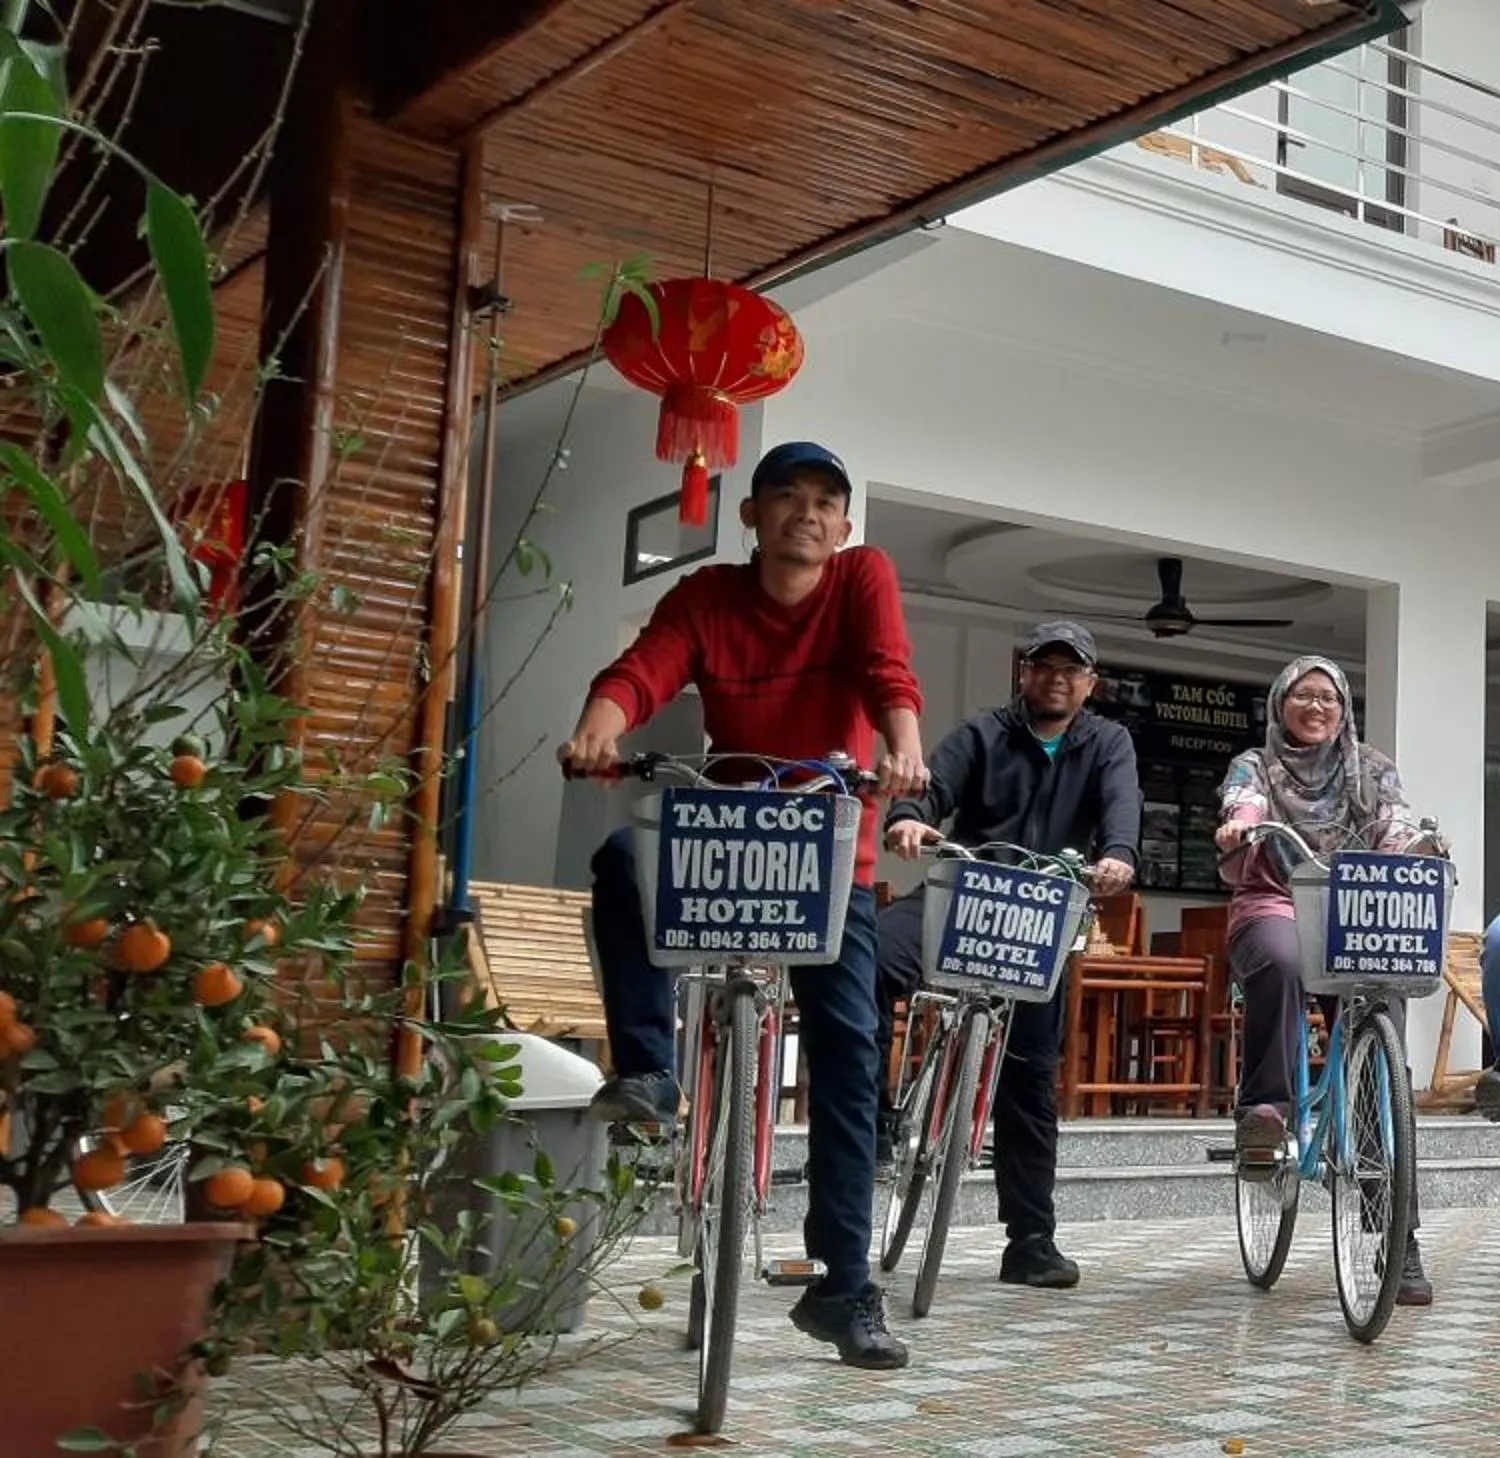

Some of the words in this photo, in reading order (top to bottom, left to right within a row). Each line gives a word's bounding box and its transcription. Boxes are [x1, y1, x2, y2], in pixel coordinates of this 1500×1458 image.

[1171, 684, 1203, 703] TAM
[1155, 702, 1211, 725] VICTORIA
[1213, 709, 1249, 729] HOTEL
[1171, 735, 1232, 753] RECEPTION
[673, 803, 746, 829] TAM
[755, 797, 825, 831] CỐC
[671, 838, 820, 892] VICTORIA
[1337, 863, 1389, 883] TAM
[1394, 860, 1439, 886] CỐC
[963, 871, 1013, 895] TAM
[1017, 879, 1064, 905] CỐC
[680, 897, 806, 925] HOTEL
[955, 894, 1056, 947] VICTORIA
[1337, 889, 1437, 930] VICTORIA
[700, 930, 744, 949] 0942
[748, 931, 781, 950] 364
[785, 931, 817, 950] 706
[956, 935, 1040, 968] HOTEL
[1344, 932, 1429, 954] HOTEL
[966, 961, 997, 977] 0942
[1358, 957, 1389, 971] 0942
[1391, 958, 1413, 971] 364
